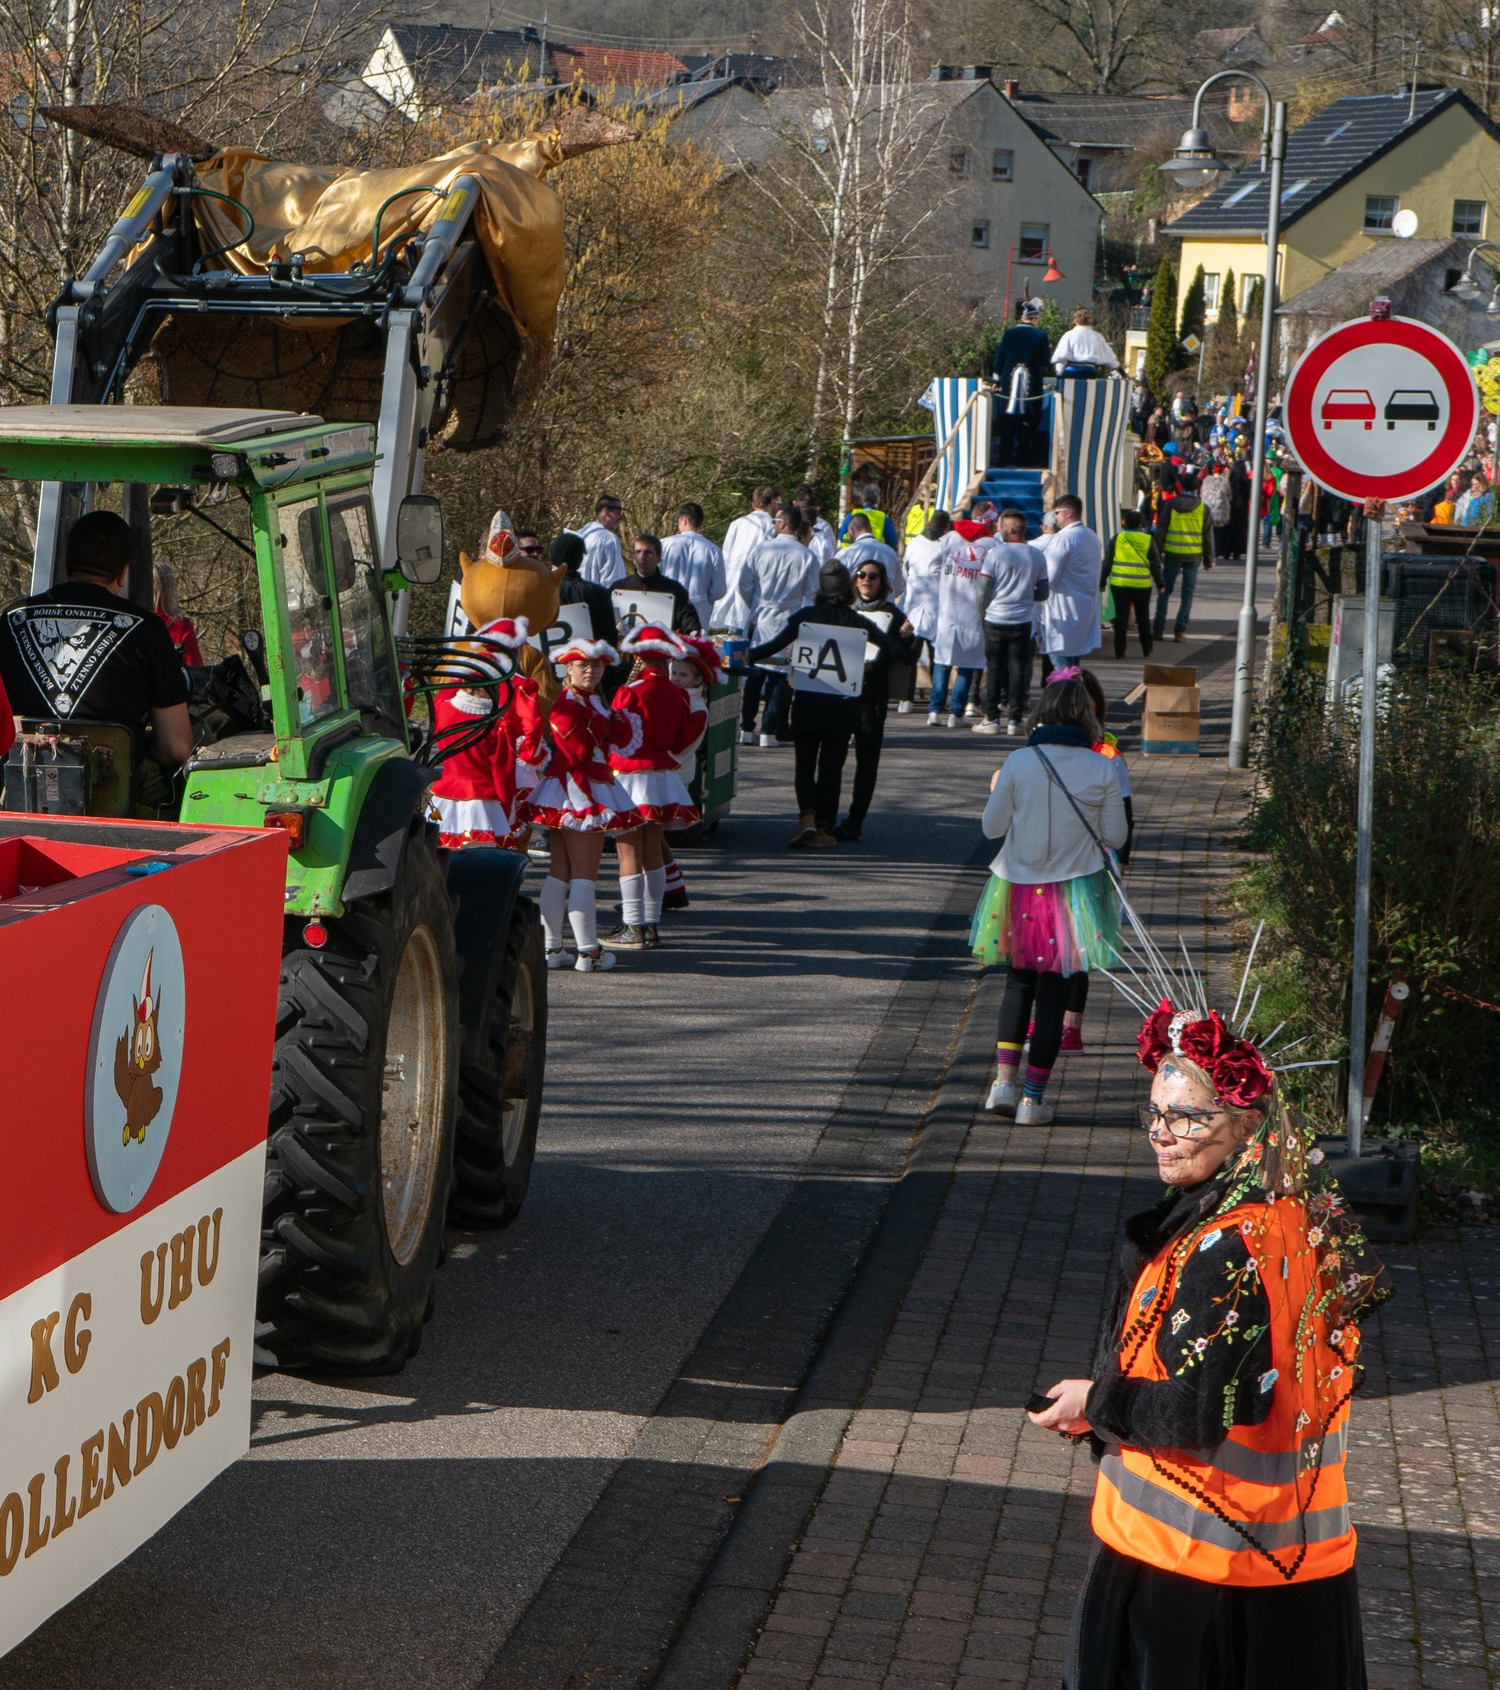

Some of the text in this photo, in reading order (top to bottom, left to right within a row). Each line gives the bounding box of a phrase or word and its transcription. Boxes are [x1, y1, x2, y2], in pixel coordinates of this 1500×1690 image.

[33, 608, 107, 619] BÖHSE ONKELZ
[70, 655, 97, 691] ONKELZ
[797, 646, 814, 665] R
[808, 638, 857, 693] A 1
[27, 1207, 224, 1404] KG UHU
